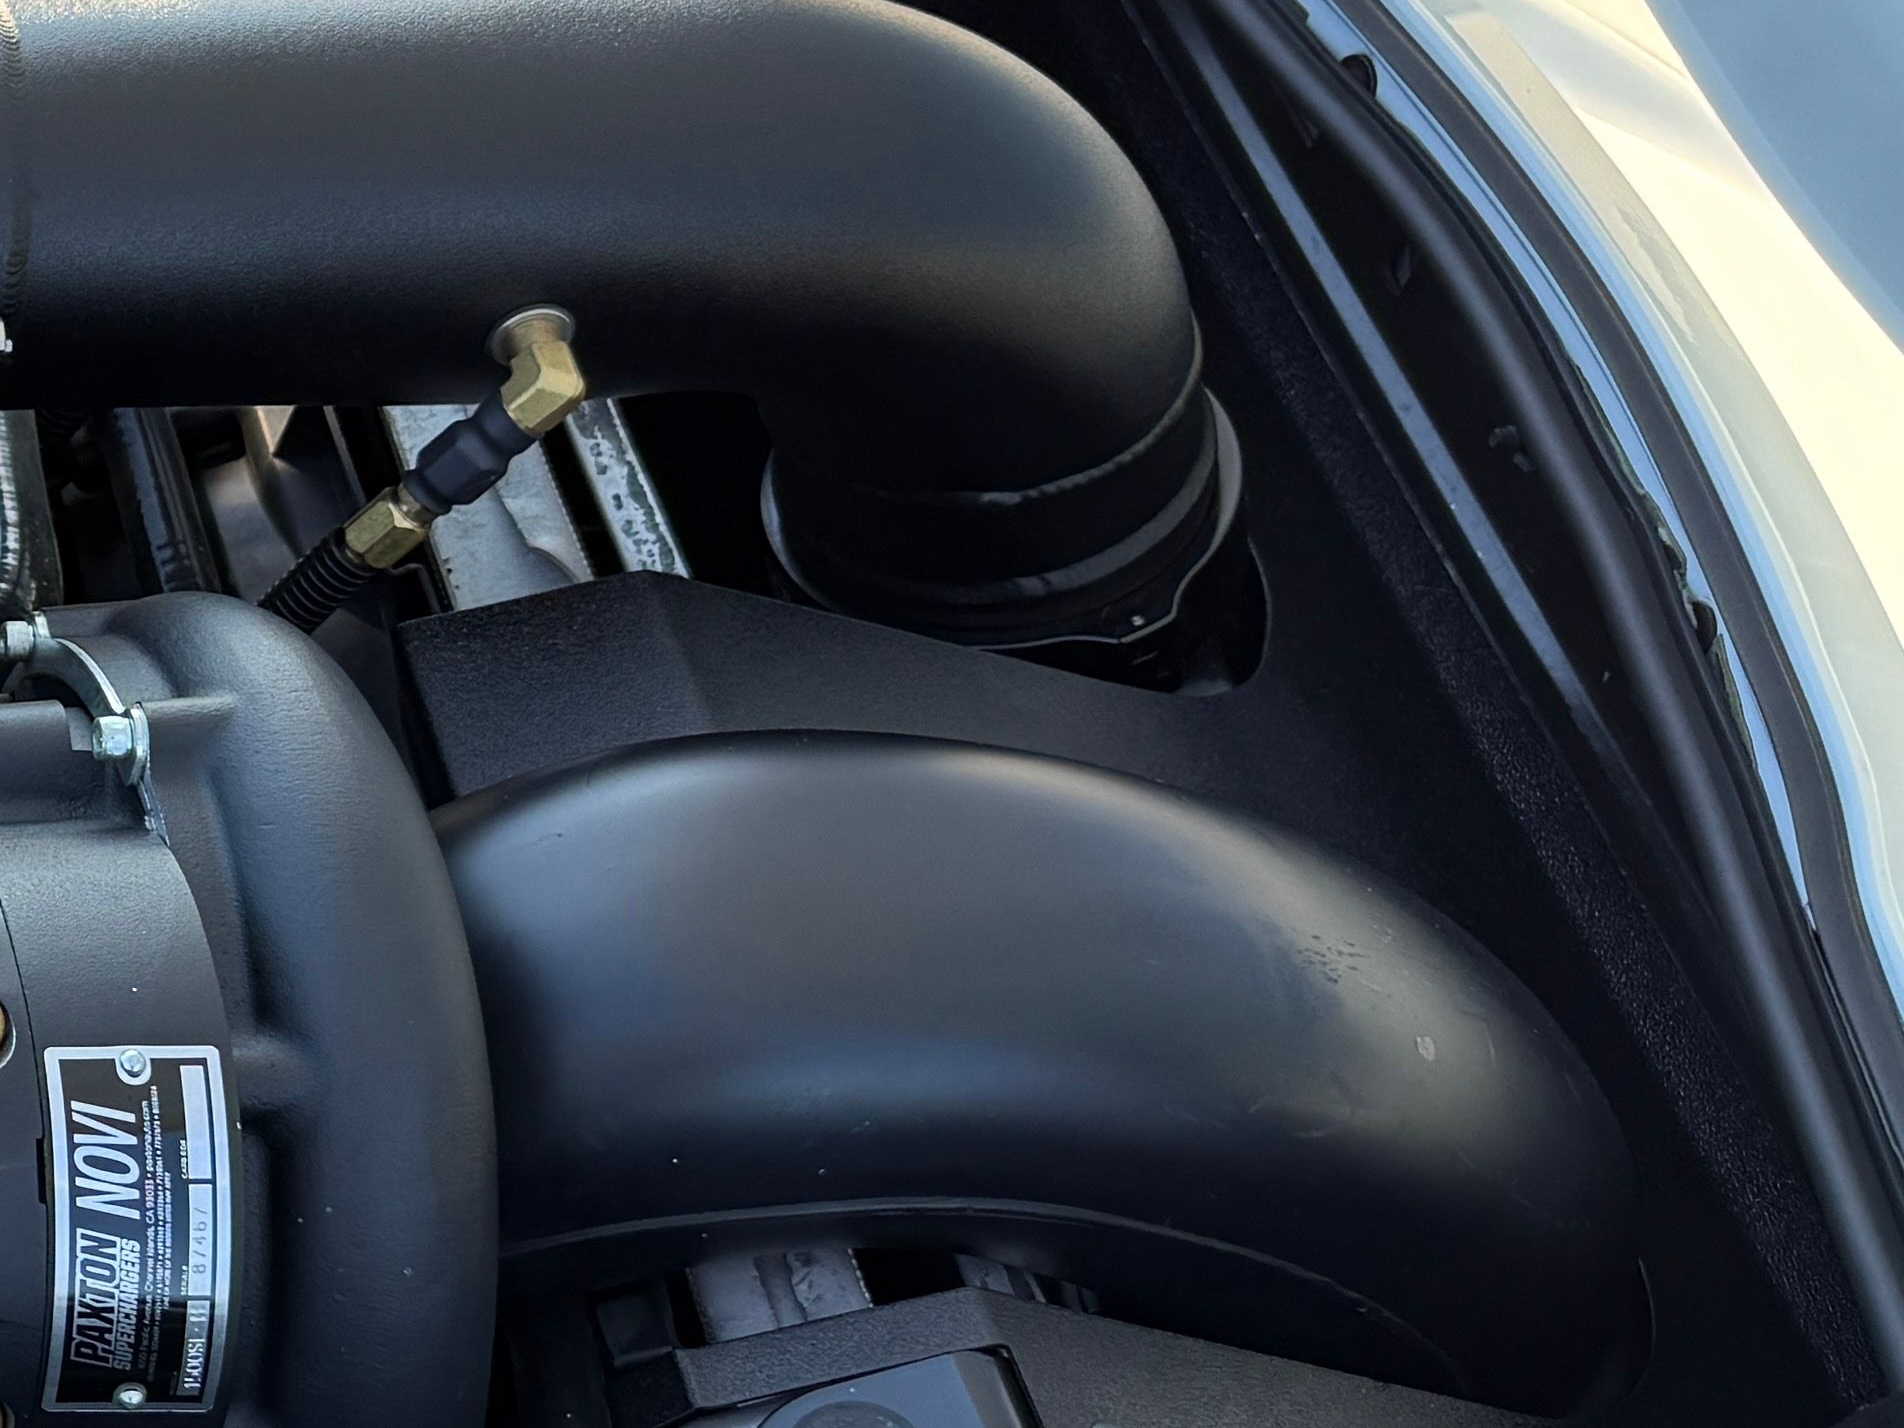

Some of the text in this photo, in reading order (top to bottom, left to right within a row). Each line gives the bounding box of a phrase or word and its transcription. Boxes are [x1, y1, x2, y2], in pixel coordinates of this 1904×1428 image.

[69, 1100, 142, 1369] PAXTON NOVI
[145, 1209, 155, 1224] CA
[112, 1236, 142, 1372] SUPERCHARGERS
